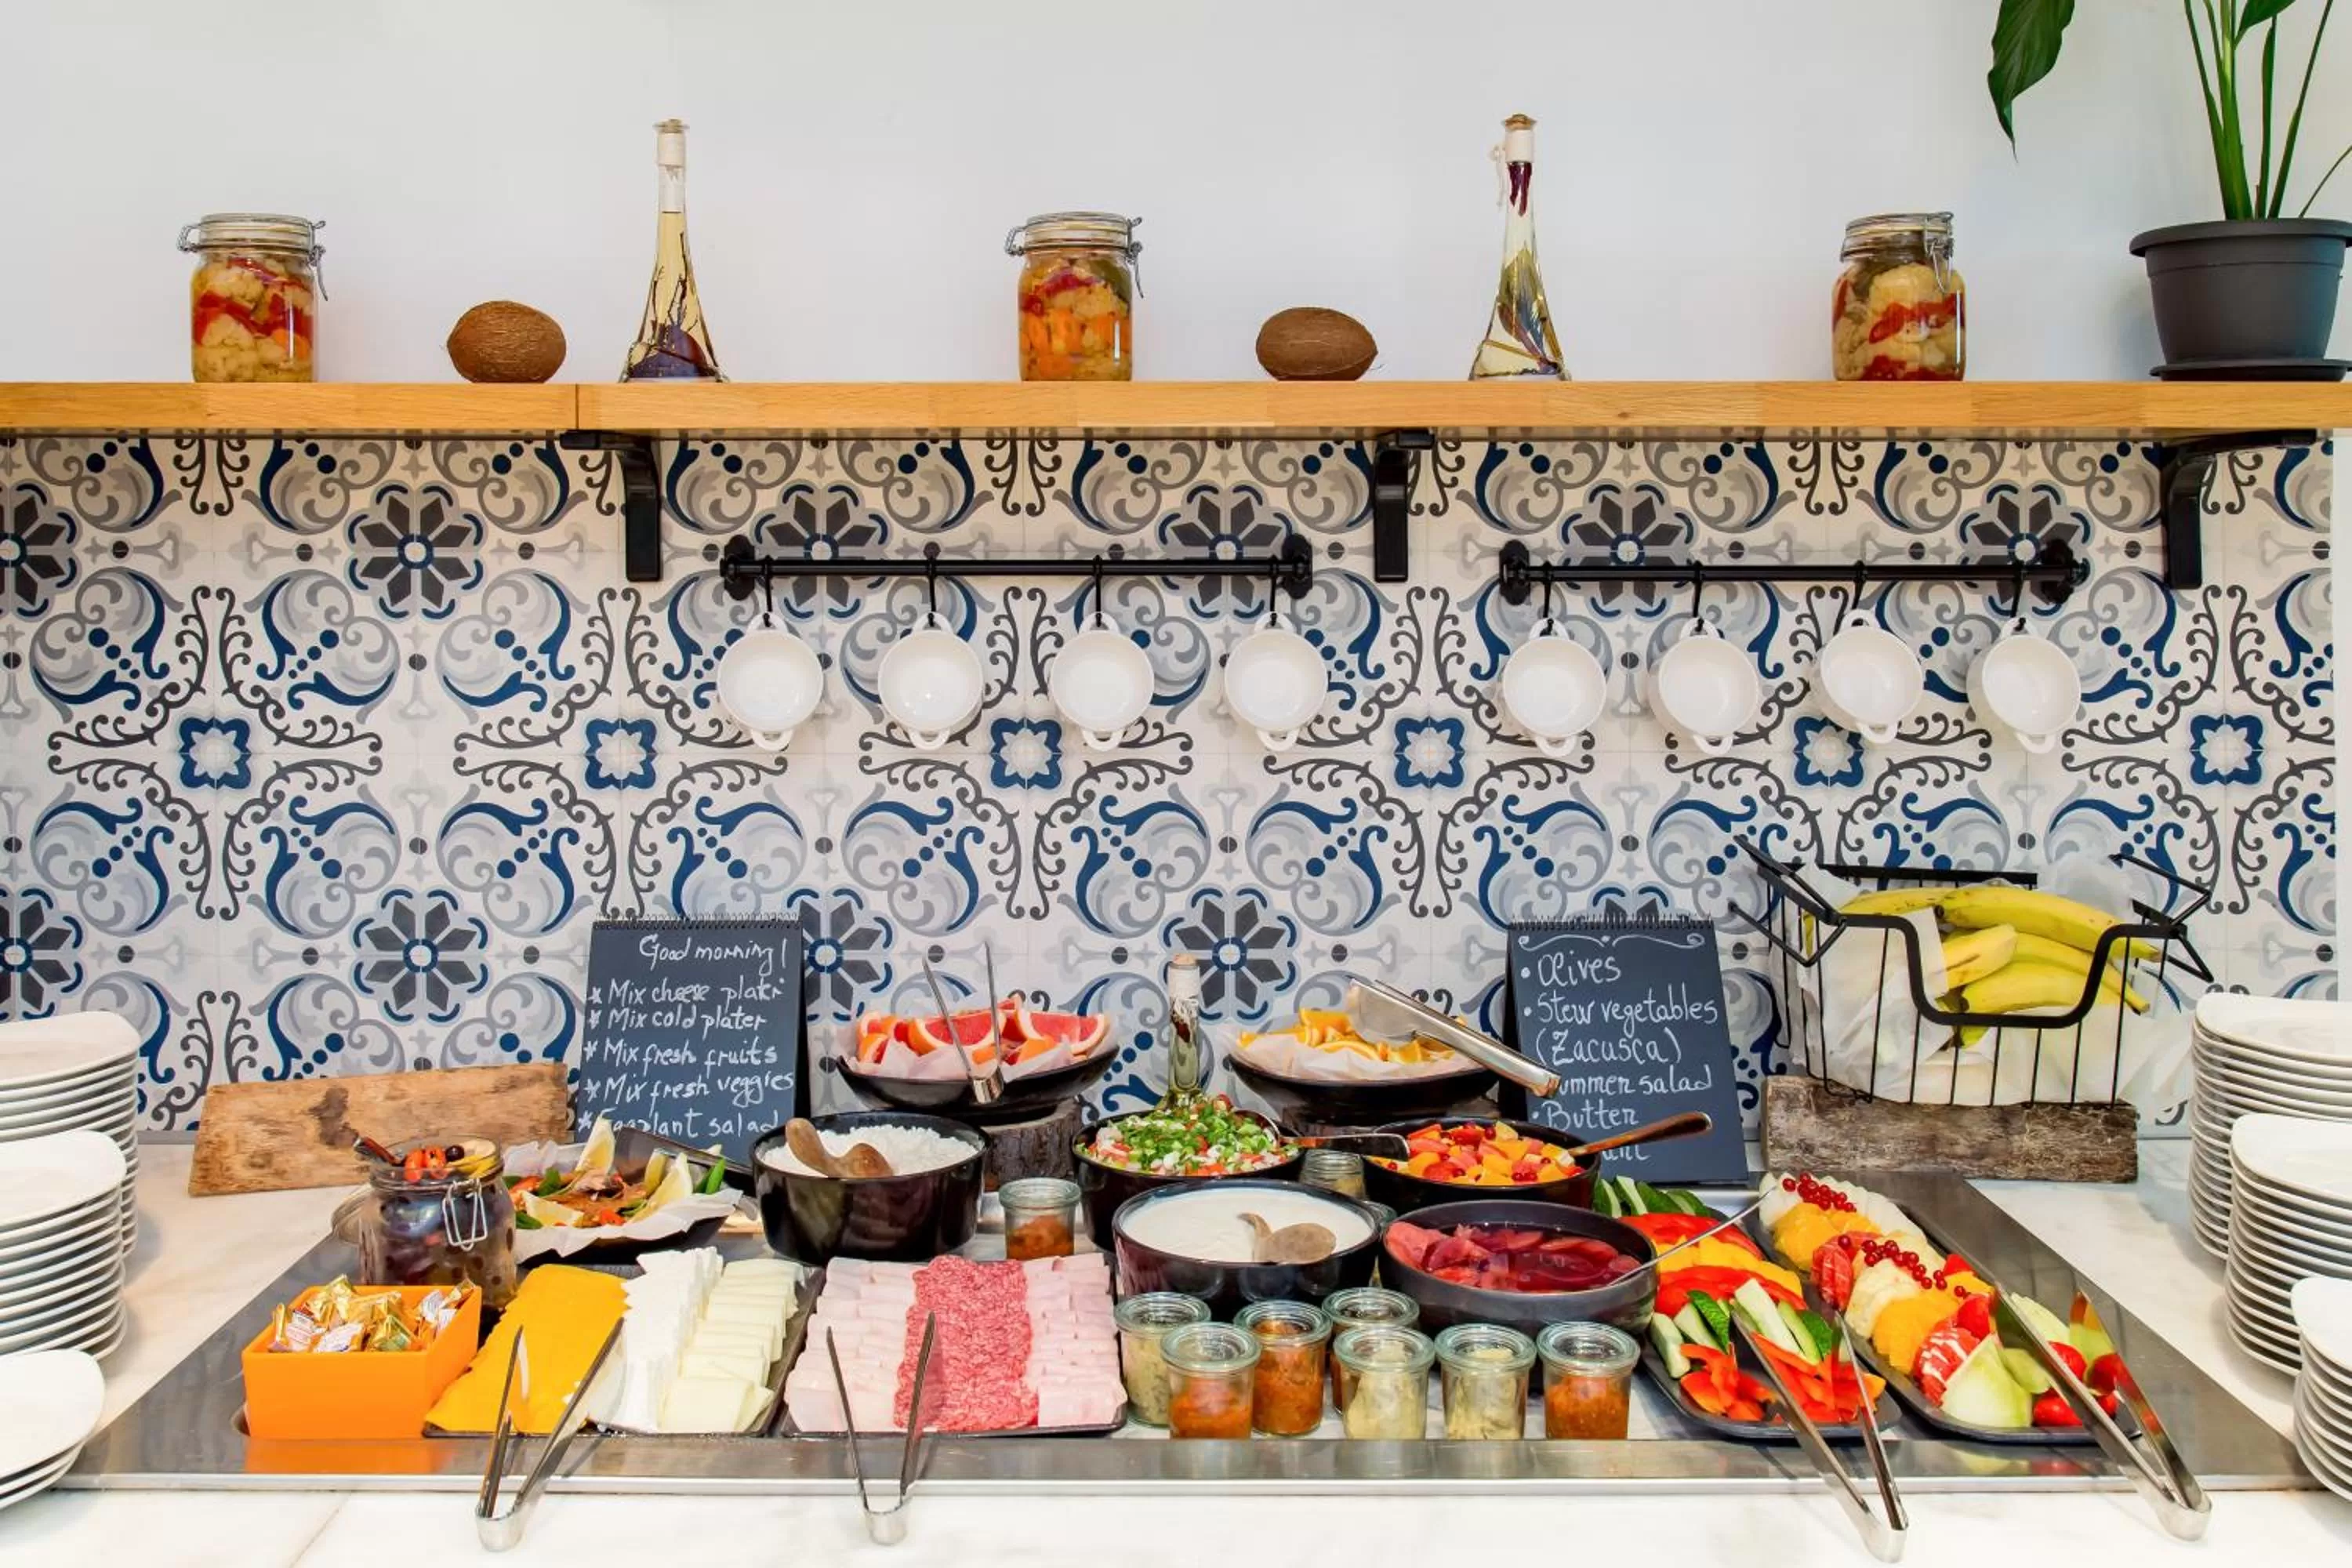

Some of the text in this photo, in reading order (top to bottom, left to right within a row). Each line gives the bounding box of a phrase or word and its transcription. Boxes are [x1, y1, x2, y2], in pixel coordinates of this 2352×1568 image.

[639, 933, 691, 971] Good
[1537, 949, 1621, 987] Olives
[608, 978, 646, 1007] Mix
[652, 977, 710, 1004] cheese
[1537, 982, 1718, 1038] Stew vegetables
[608, 1003, 768, 1041] Mix cold plater
[603, 1036, 779, 1079] Mix fresh fruits
[603, 1070, 794, 1118] Mix fresh veggies
[1559, 1063, 1712, 1096] ummer salad
[709, 1109, 779, 1138] salad
[1541, 1098, 1639, 1131] Butter
